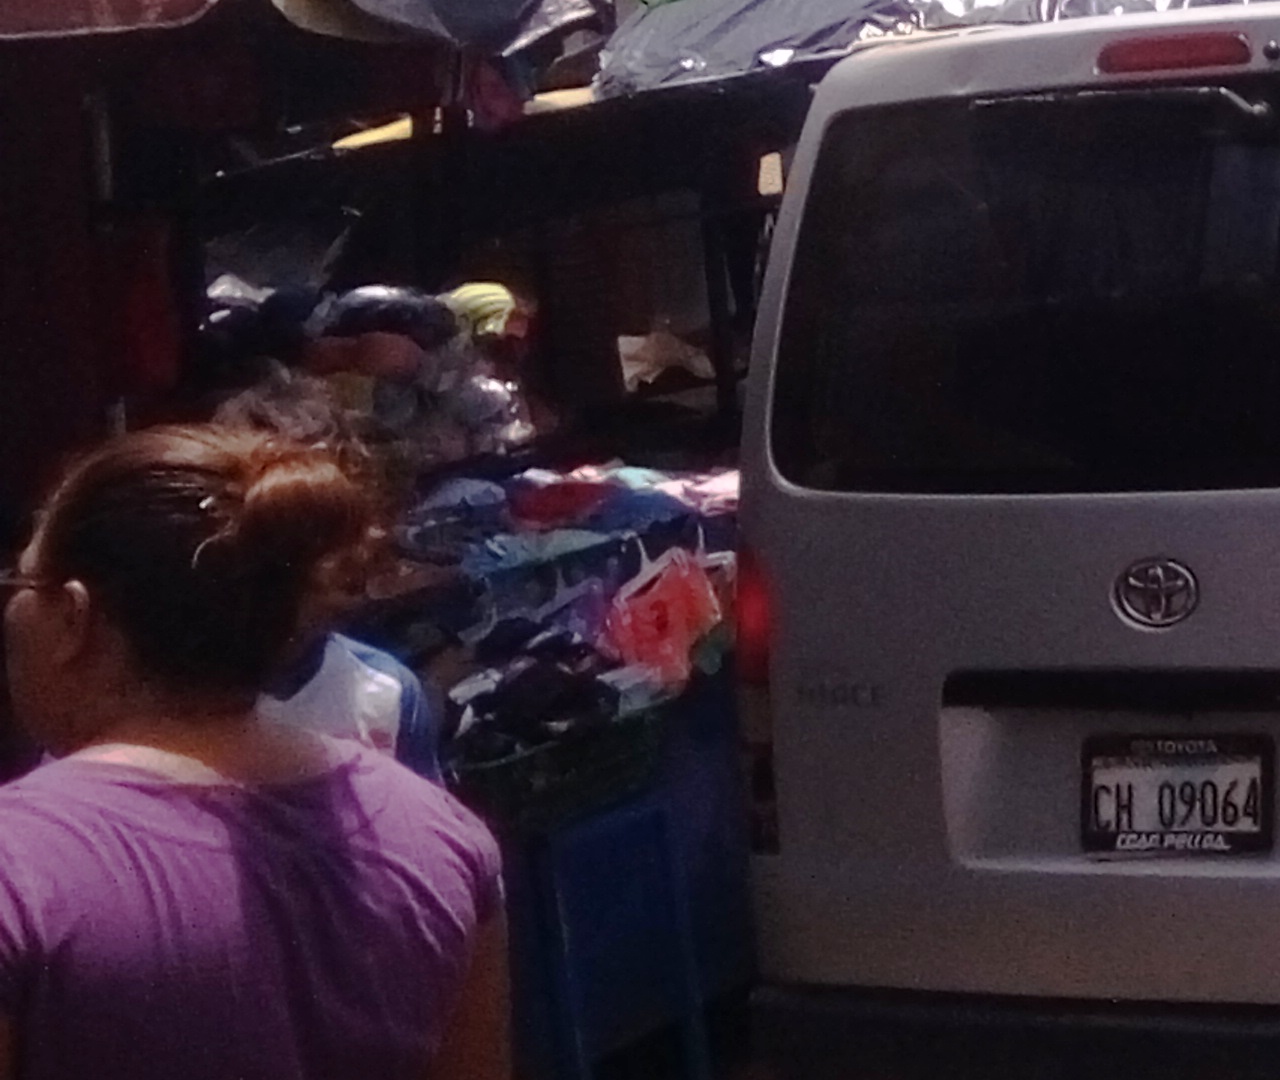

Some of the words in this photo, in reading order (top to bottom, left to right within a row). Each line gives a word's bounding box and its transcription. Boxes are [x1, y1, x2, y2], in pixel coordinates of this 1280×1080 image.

[1155, 739, 1218, 754] TOYOTA
[1094, 782, 1133, 831] CH
[1158, 776, 1260, 829] 09064
